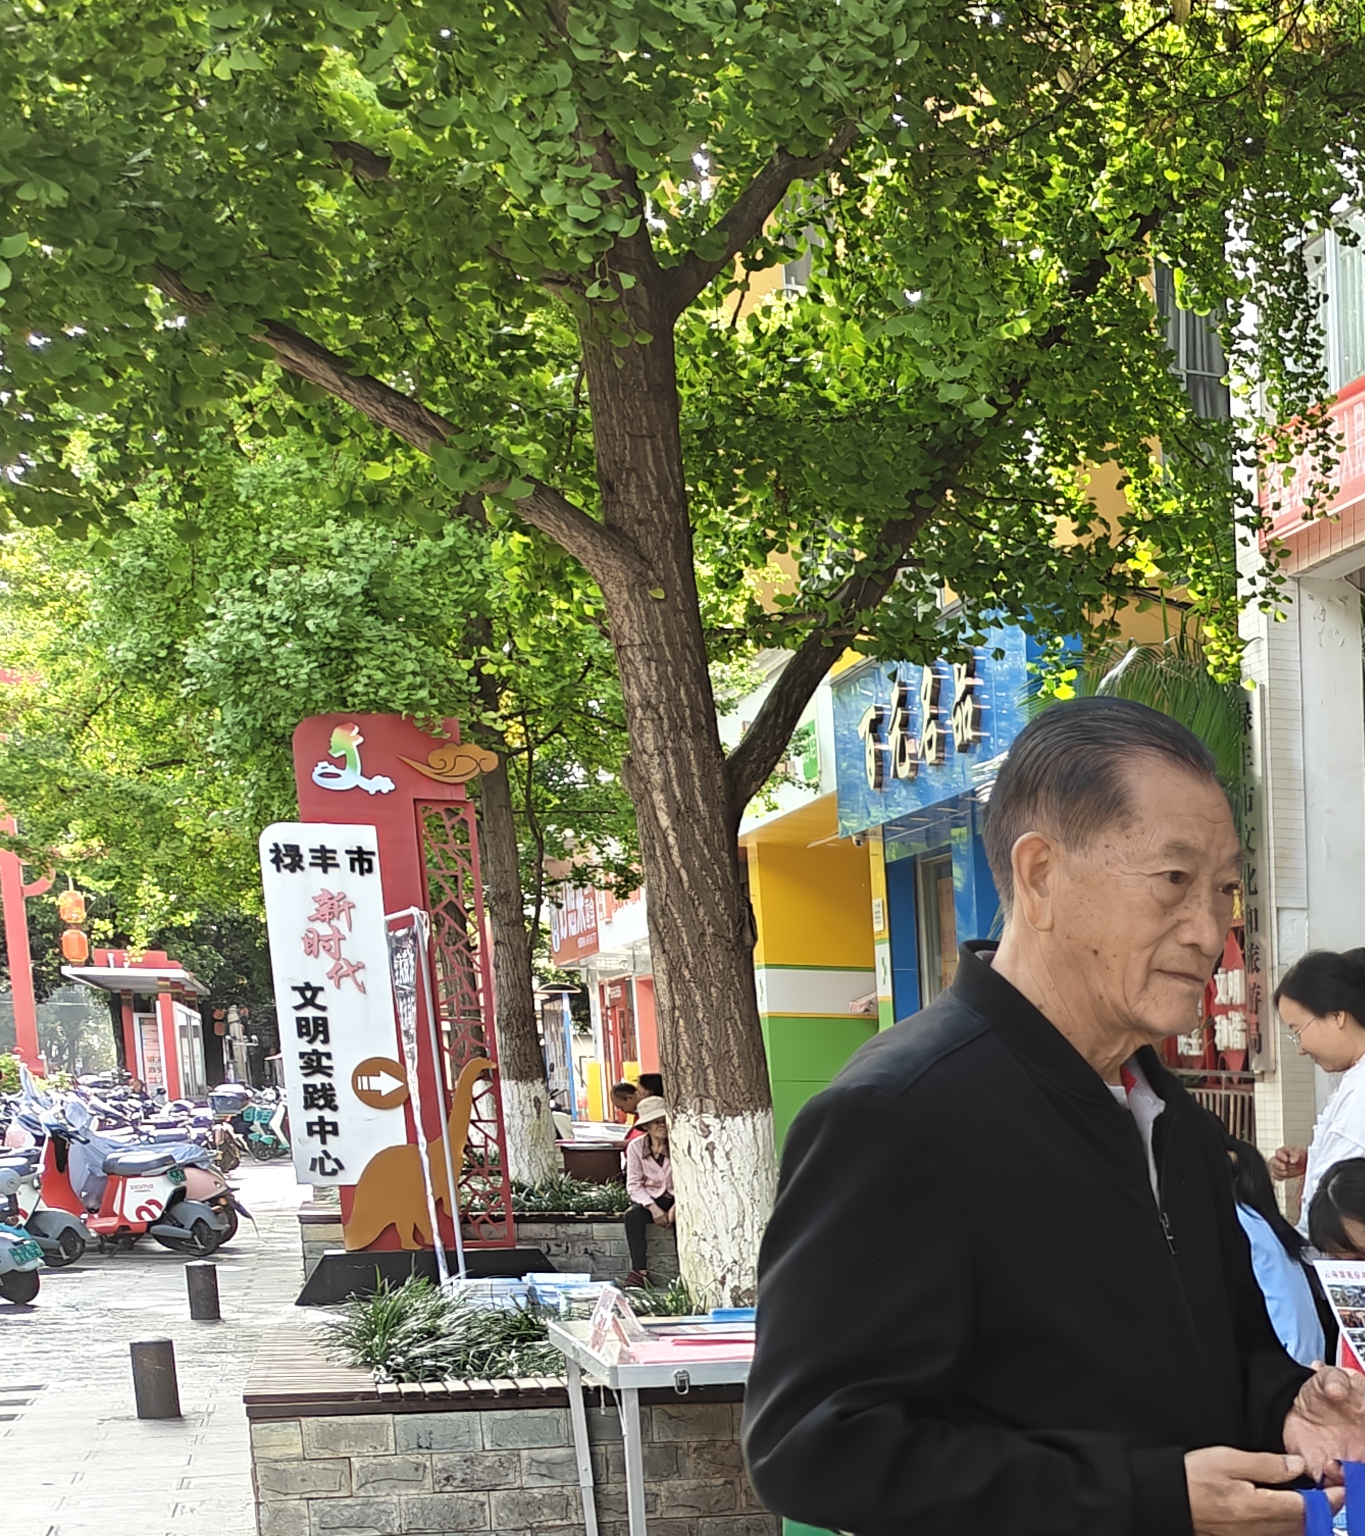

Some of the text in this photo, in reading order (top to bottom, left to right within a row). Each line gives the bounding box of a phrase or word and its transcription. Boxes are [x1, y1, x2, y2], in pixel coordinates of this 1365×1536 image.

[269, 842, 377, 876] 禄丰市
[301, 888, 367, 995] 新时代
[1213, 967, 1246, 1005] 文明
[291, 981, 346, 1178] 文明实践中心
